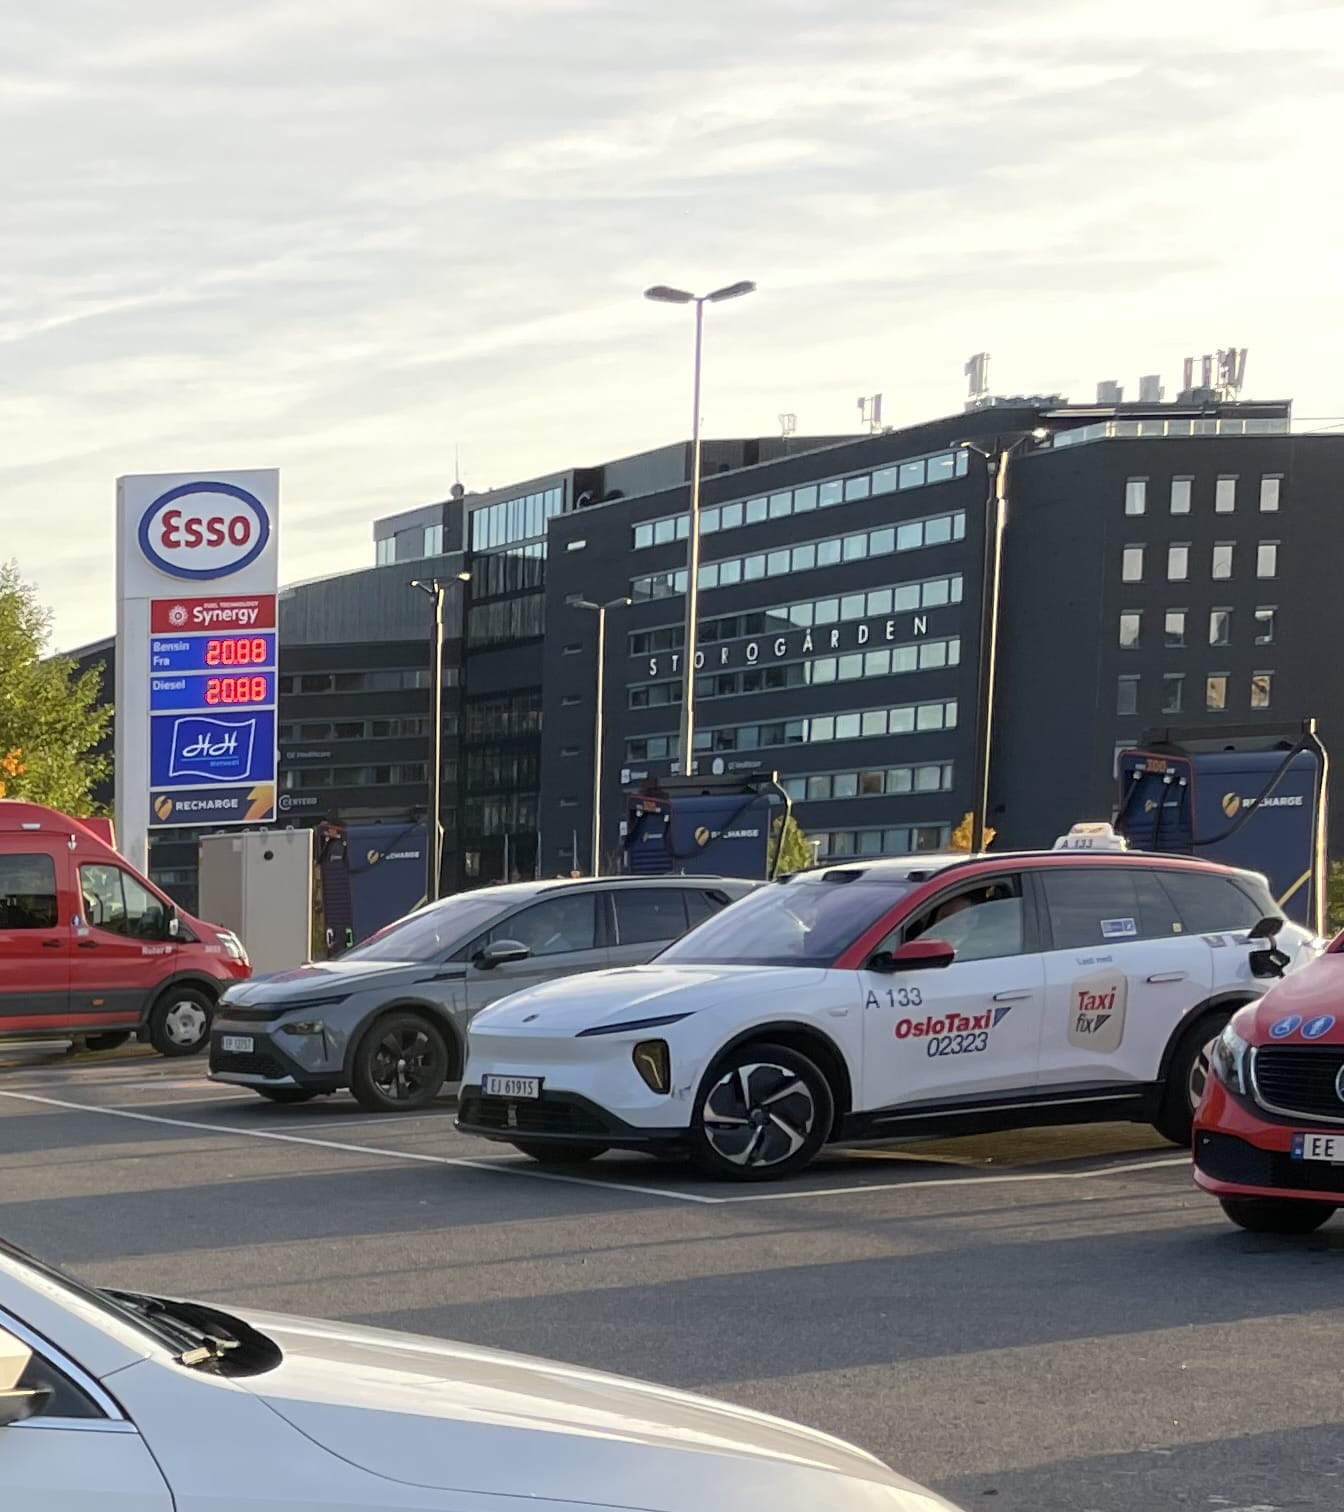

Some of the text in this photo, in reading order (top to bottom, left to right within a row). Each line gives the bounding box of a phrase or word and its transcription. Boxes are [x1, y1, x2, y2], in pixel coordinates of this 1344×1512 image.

[161, 510, 251, 548] Esso
[192, 606, 259, 626] Synergy
[153, 640, 190, 652] Bensin
[153, 655, 170, 667] Fra
[152, 679, 186, 691] Diesel
[175, 798, 238, 811] RECHARGE
[865, 987, 923, 1010] A 133
[1077, 986, 1117, 1011] Taxi
[895, 1009, 993, 1039] OsloTaxi
[1075, 1013, 1094, 1034] fix
[926, 1031, 989, 1058] 02323
[491, 1078, 534, 1095] EJ 61915
[1312, 1137, 1335, 1157] EE
